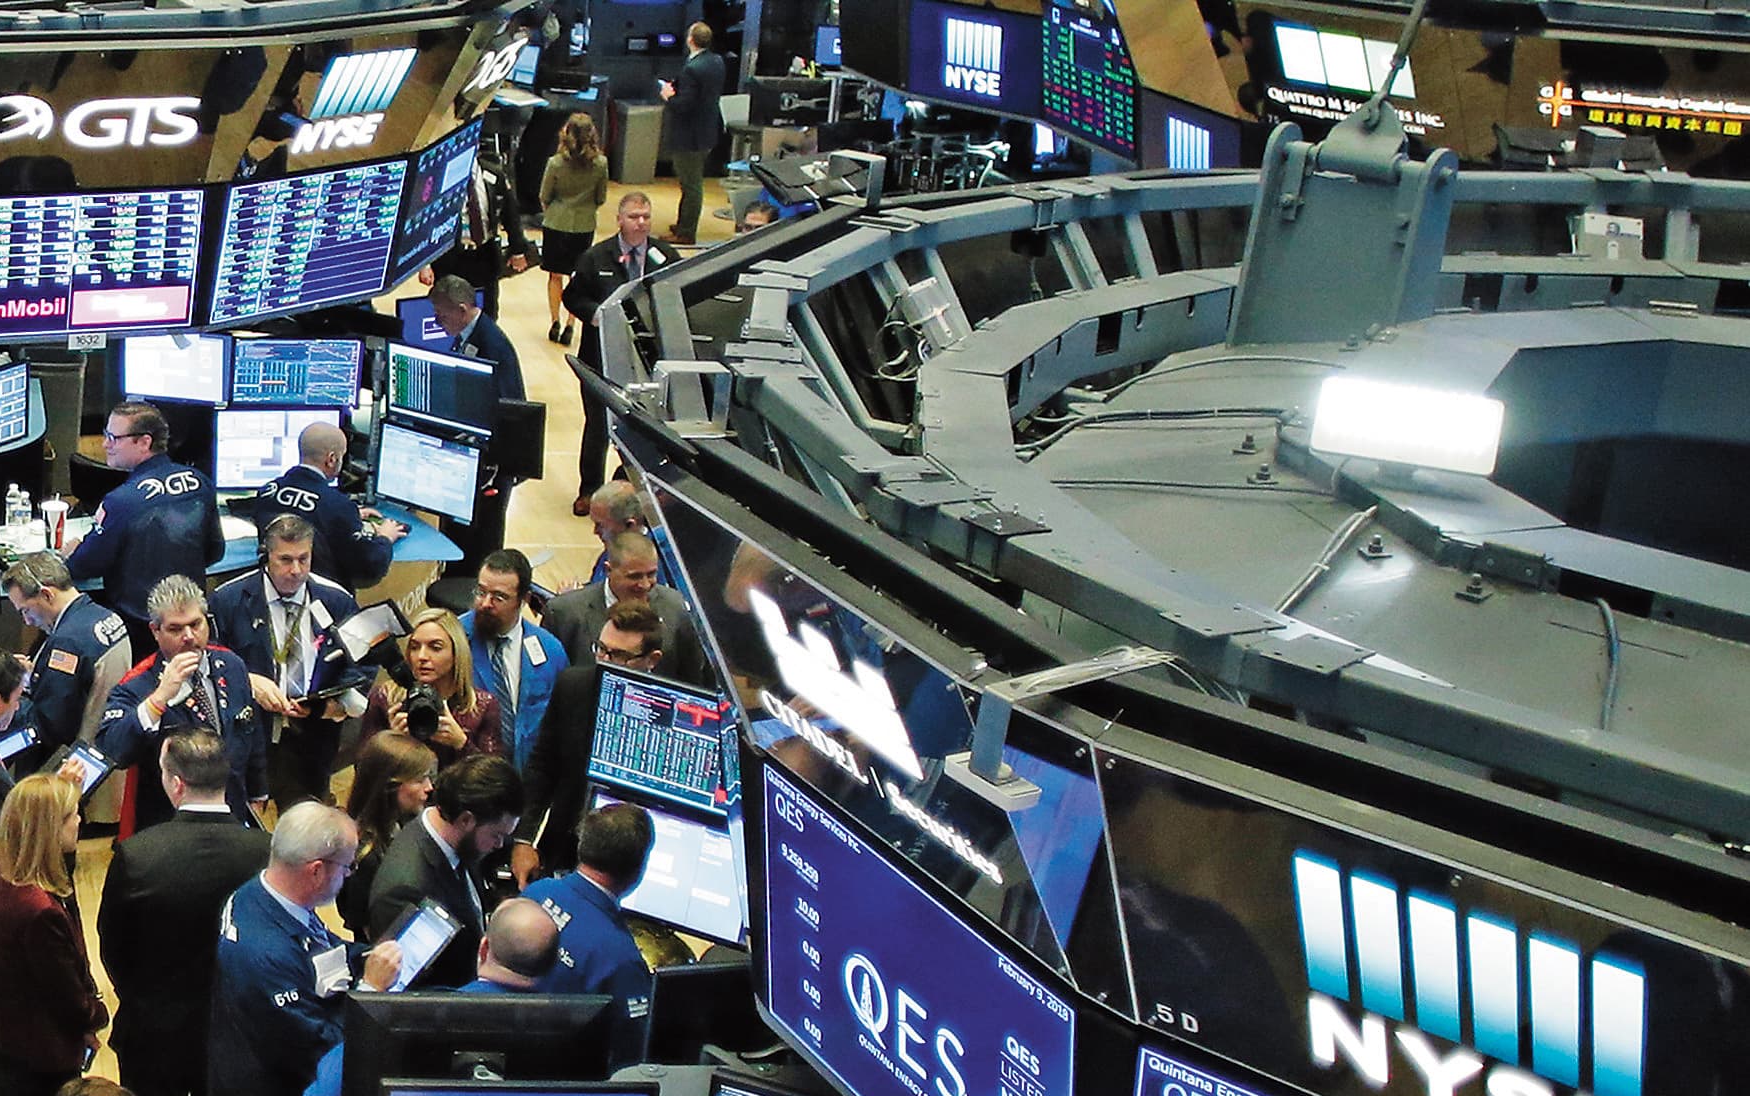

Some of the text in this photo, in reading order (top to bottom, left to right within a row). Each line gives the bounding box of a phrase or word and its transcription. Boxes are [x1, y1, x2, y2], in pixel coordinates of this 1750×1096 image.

[945, 65, 1000, 96] NYSE
[1267, 87, 1326, 109] QUATTRO
[63, 97, 201, 148] GTS
[292, 112, 385, 153] NYSE
[76, 335, 99, 345] 1632
[165, 470, 200, 496] GTS
[276, 487, 319, 512] GTS
[775, 793, 804, 833] QES
[886, 780, 1003, 884] Securities
[781, 843, 819, 884] 9,259,259
[797, 898, 820, 925] 10.00
[802, 940, 821, 964] 0.00
[803, 979, 821, 1003] 0.00
[998, 957, 1035, 996] February
[1046, 998, 1068, 1023] 2018
[804, 1018, 821, 1042] 0.00
[858, 1034, 894, 1074] QUINTANA
[1006, 1036, 1040, 1076] QES
[1149, 1057, 1213, 1094] Quintana
